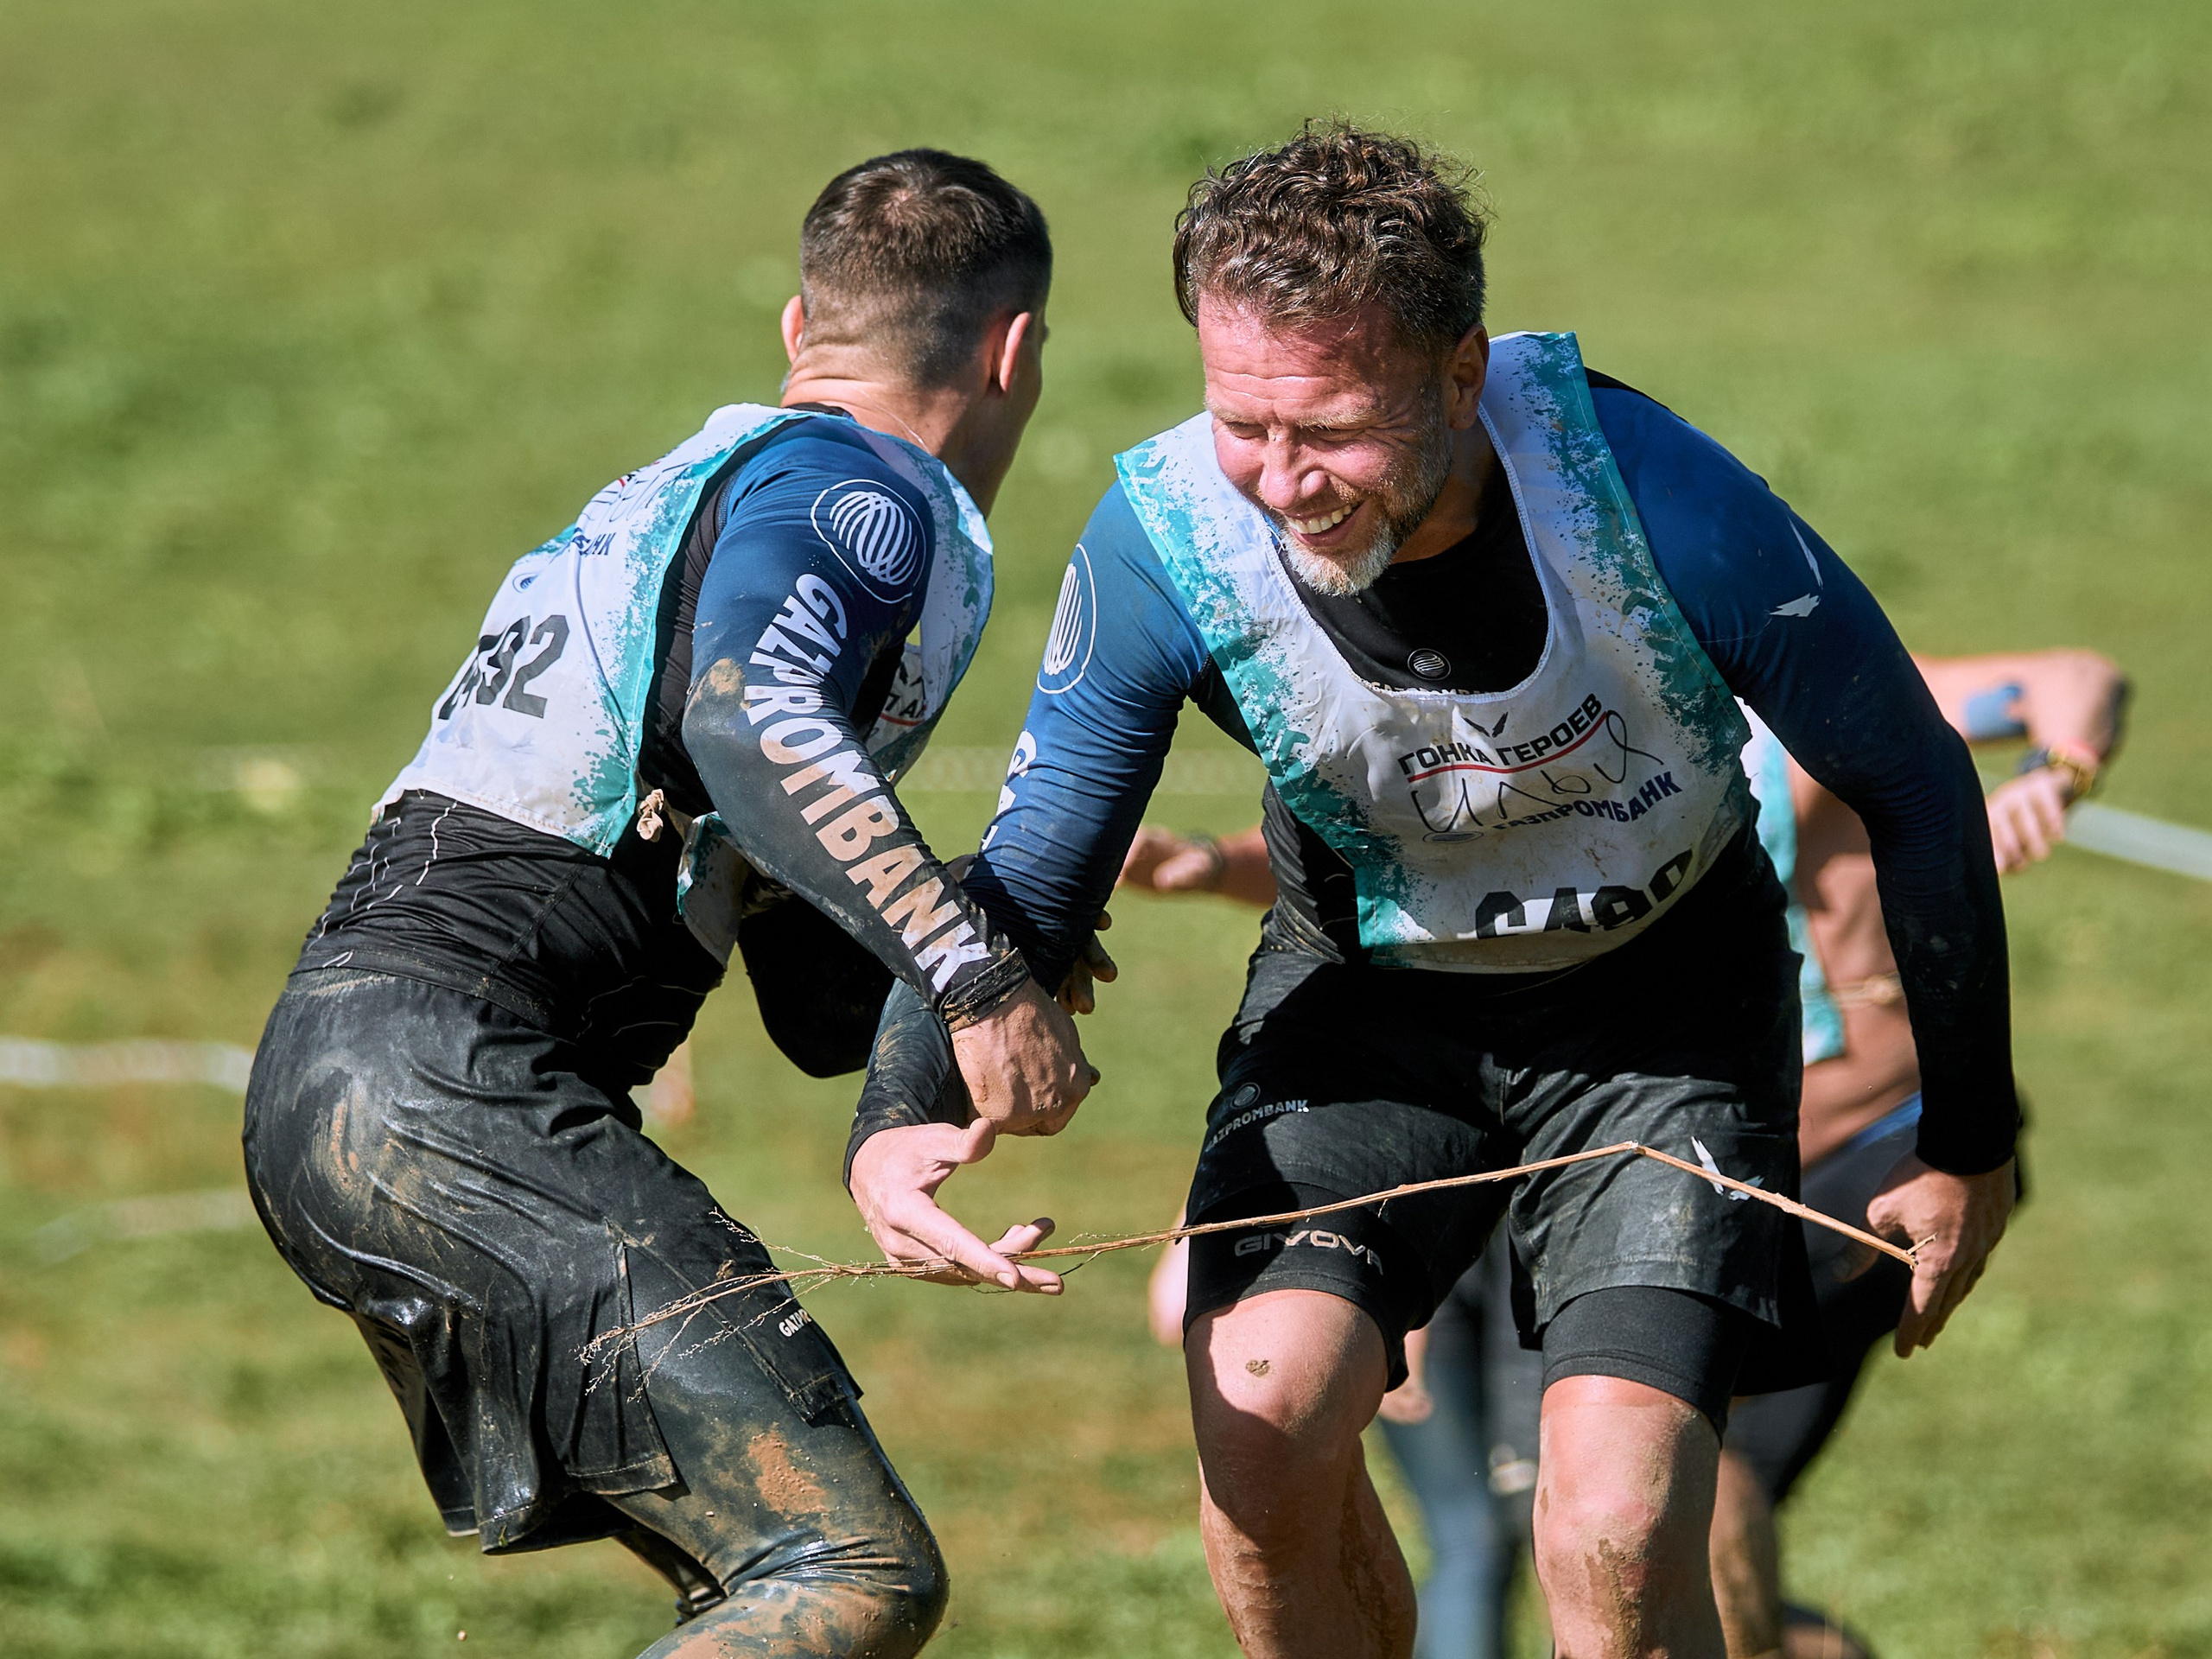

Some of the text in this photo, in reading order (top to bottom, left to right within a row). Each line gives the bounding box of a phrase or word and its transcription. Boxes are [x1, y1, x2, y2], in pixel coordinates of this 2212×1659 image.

[744, 574, 992, 994] GAZPROMBANK
[1397, 693, 1602, 775] ГОНКА ГЕРОЕВ
